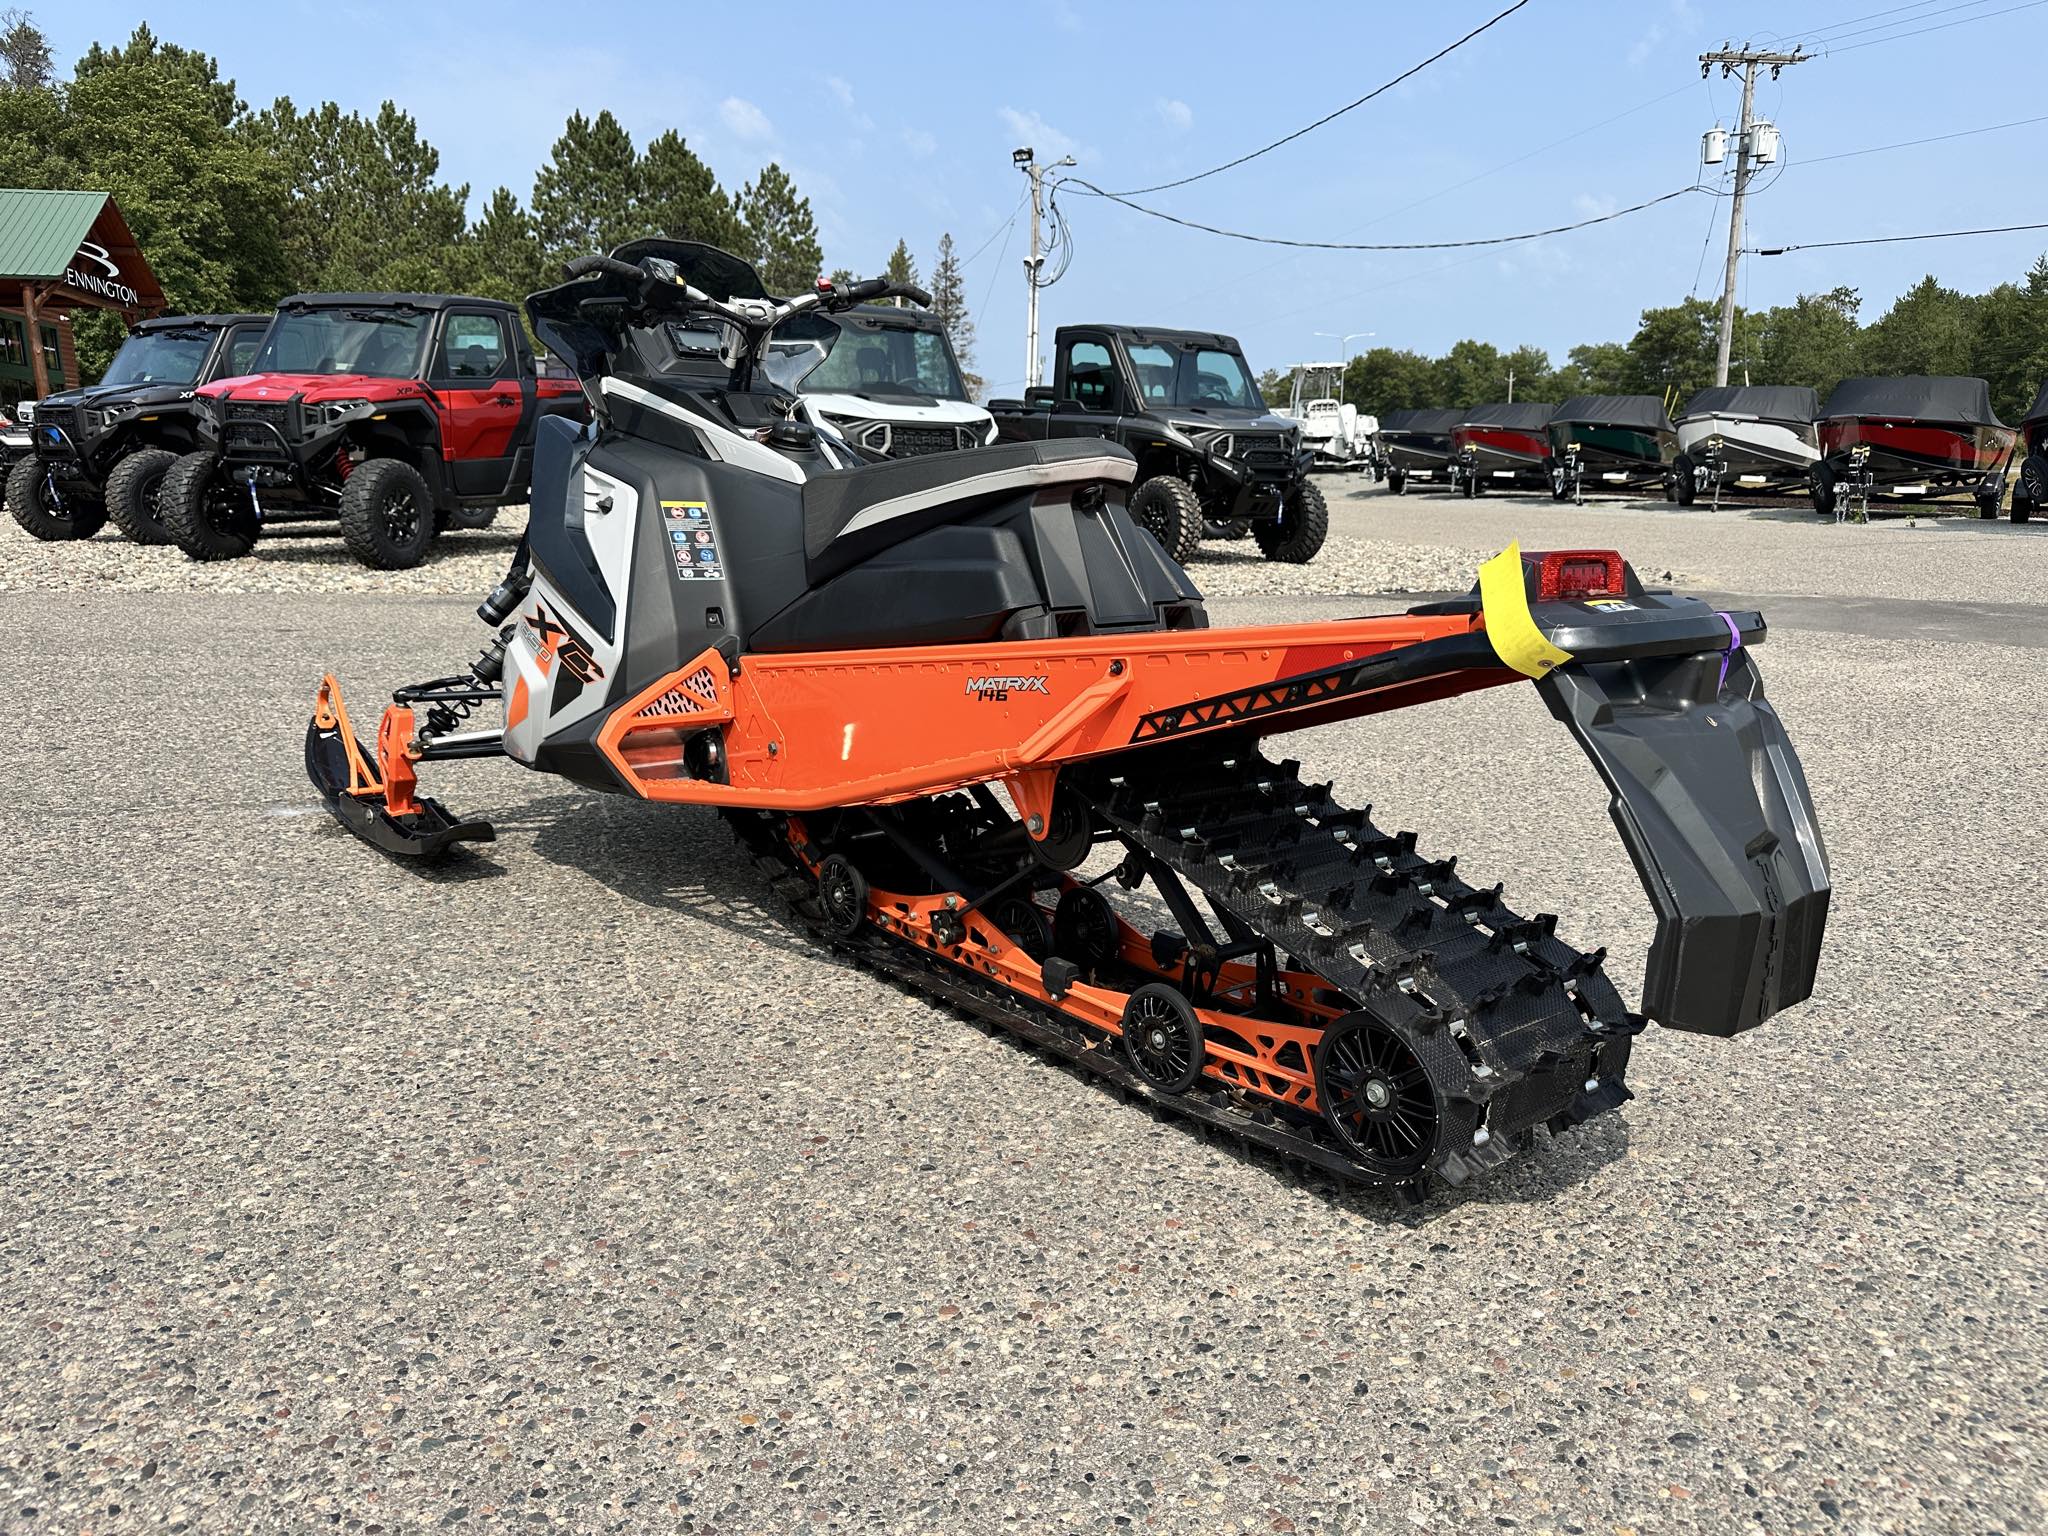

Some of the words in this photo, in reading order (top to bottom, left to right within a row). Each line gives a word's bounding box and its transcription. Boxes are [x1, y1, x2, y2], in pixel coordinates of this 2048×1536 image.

[64, 267, 138, 304] ENNINGTON
[893, 434, 953, 446] POLARIS
[965, 675, 1050, 695] MATRYX
[977, 689, 1008, 702] 146
